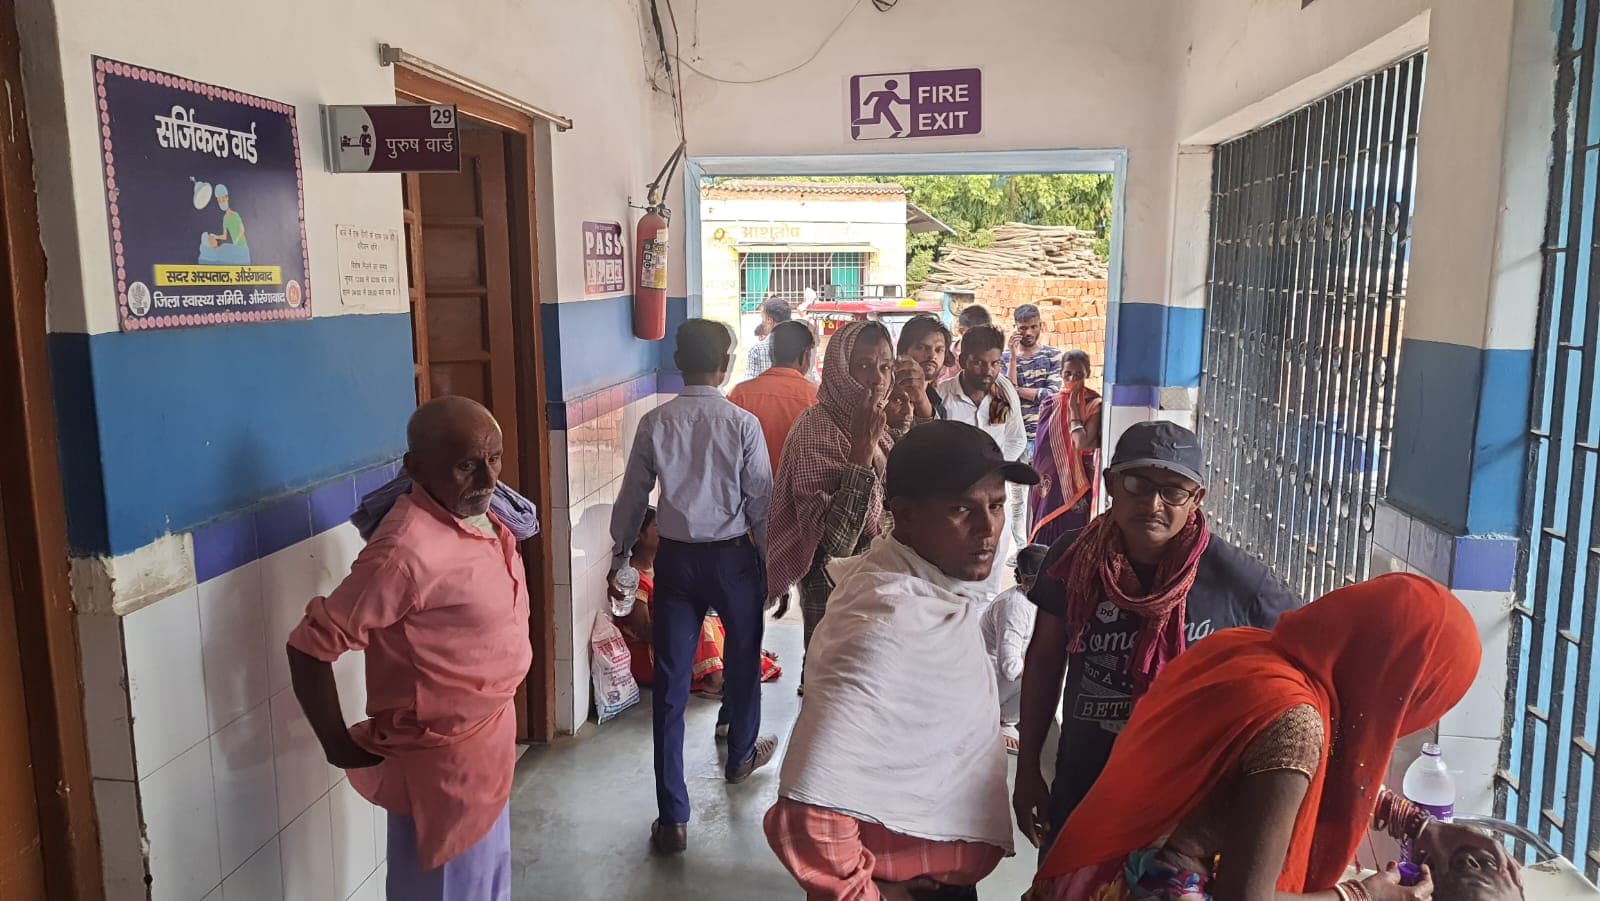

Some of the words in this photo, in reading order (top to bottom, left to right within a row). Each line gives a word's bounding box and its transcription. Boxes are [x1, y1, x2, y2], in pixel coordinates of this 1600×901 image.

[918, 84, 969, 104] FIRE
[432, 109, 452, 124] 29
[918, 111, 969, 131] EXIT
[154, 105, 229, 158] सर्जिकल
[230, 121, 258, 164] वार्ड
[385, 138, 419, 159] पुरुष
[424, 132, 453, 153] वार्ड
[585, 231, 622, 256] PASS
[166, 271, 189, 283] सदर
[153, 291, 180, 308] जिला
